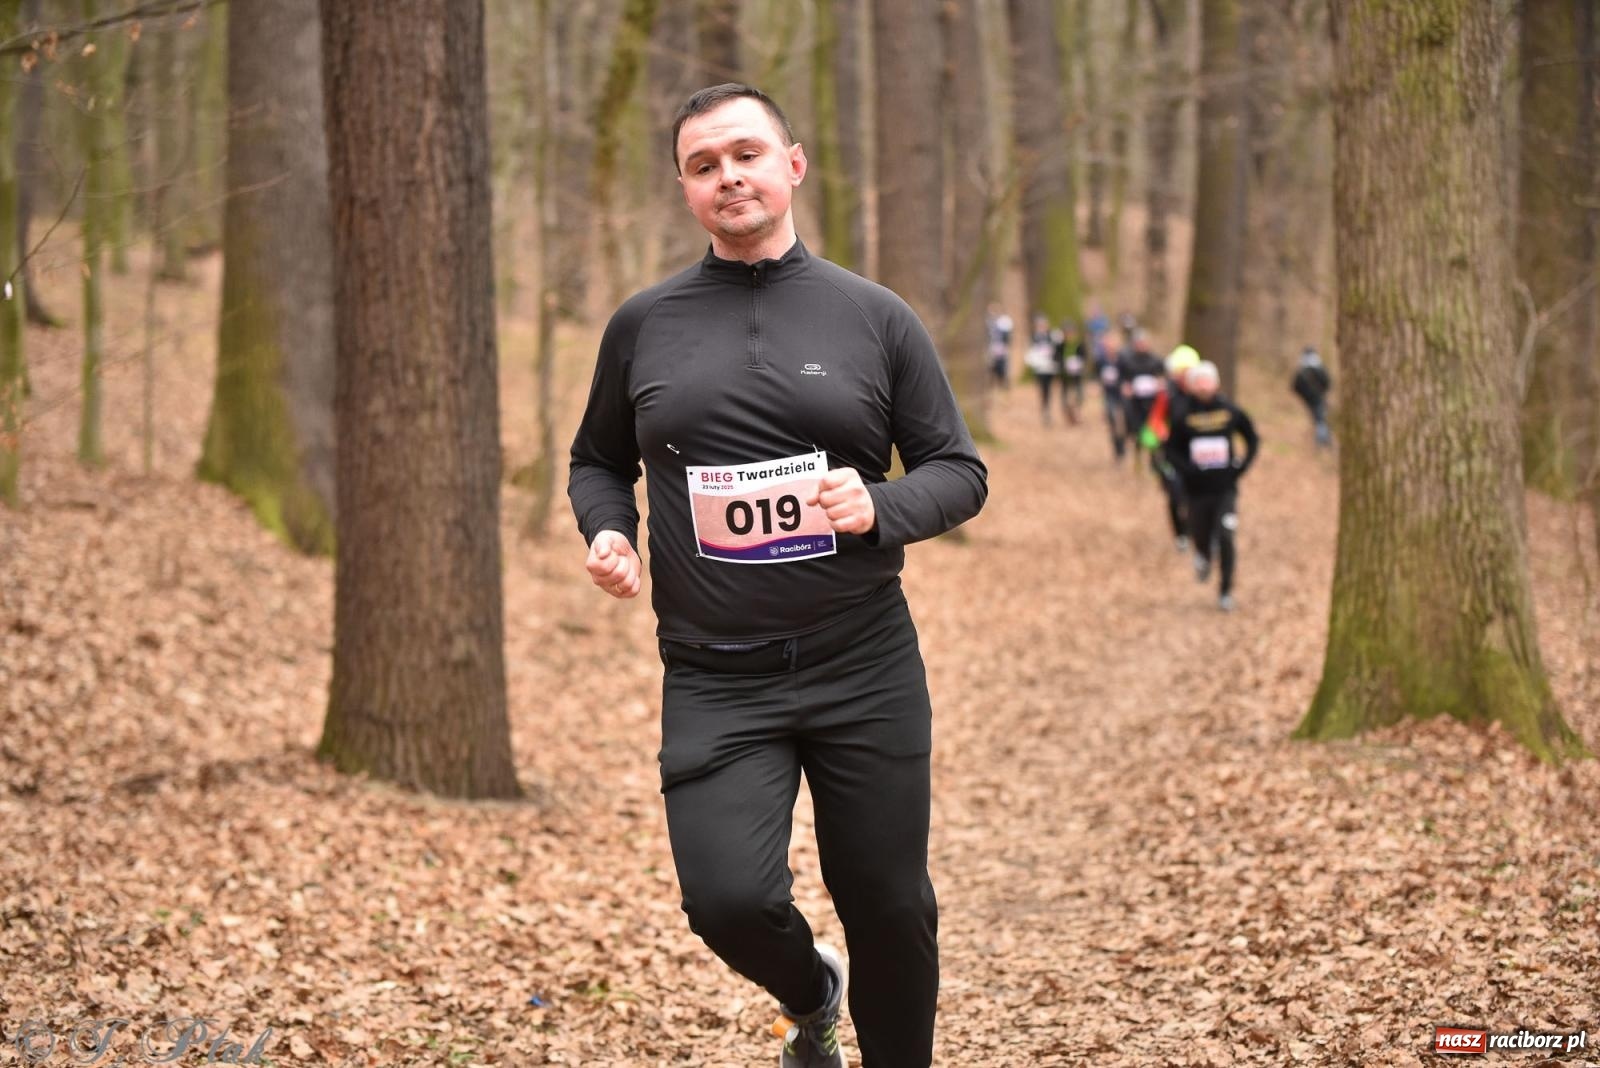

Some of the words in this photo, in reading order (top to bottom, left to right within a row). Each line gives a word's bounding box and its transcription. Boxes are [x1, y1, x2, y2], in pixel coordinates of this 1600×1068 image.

[701, 472, 733, 483] BIEG
[737, 461, 816, 482] Twardziela
[725, 494, 801, 536] 019
[780, 543, 812, 554] Racibórz
